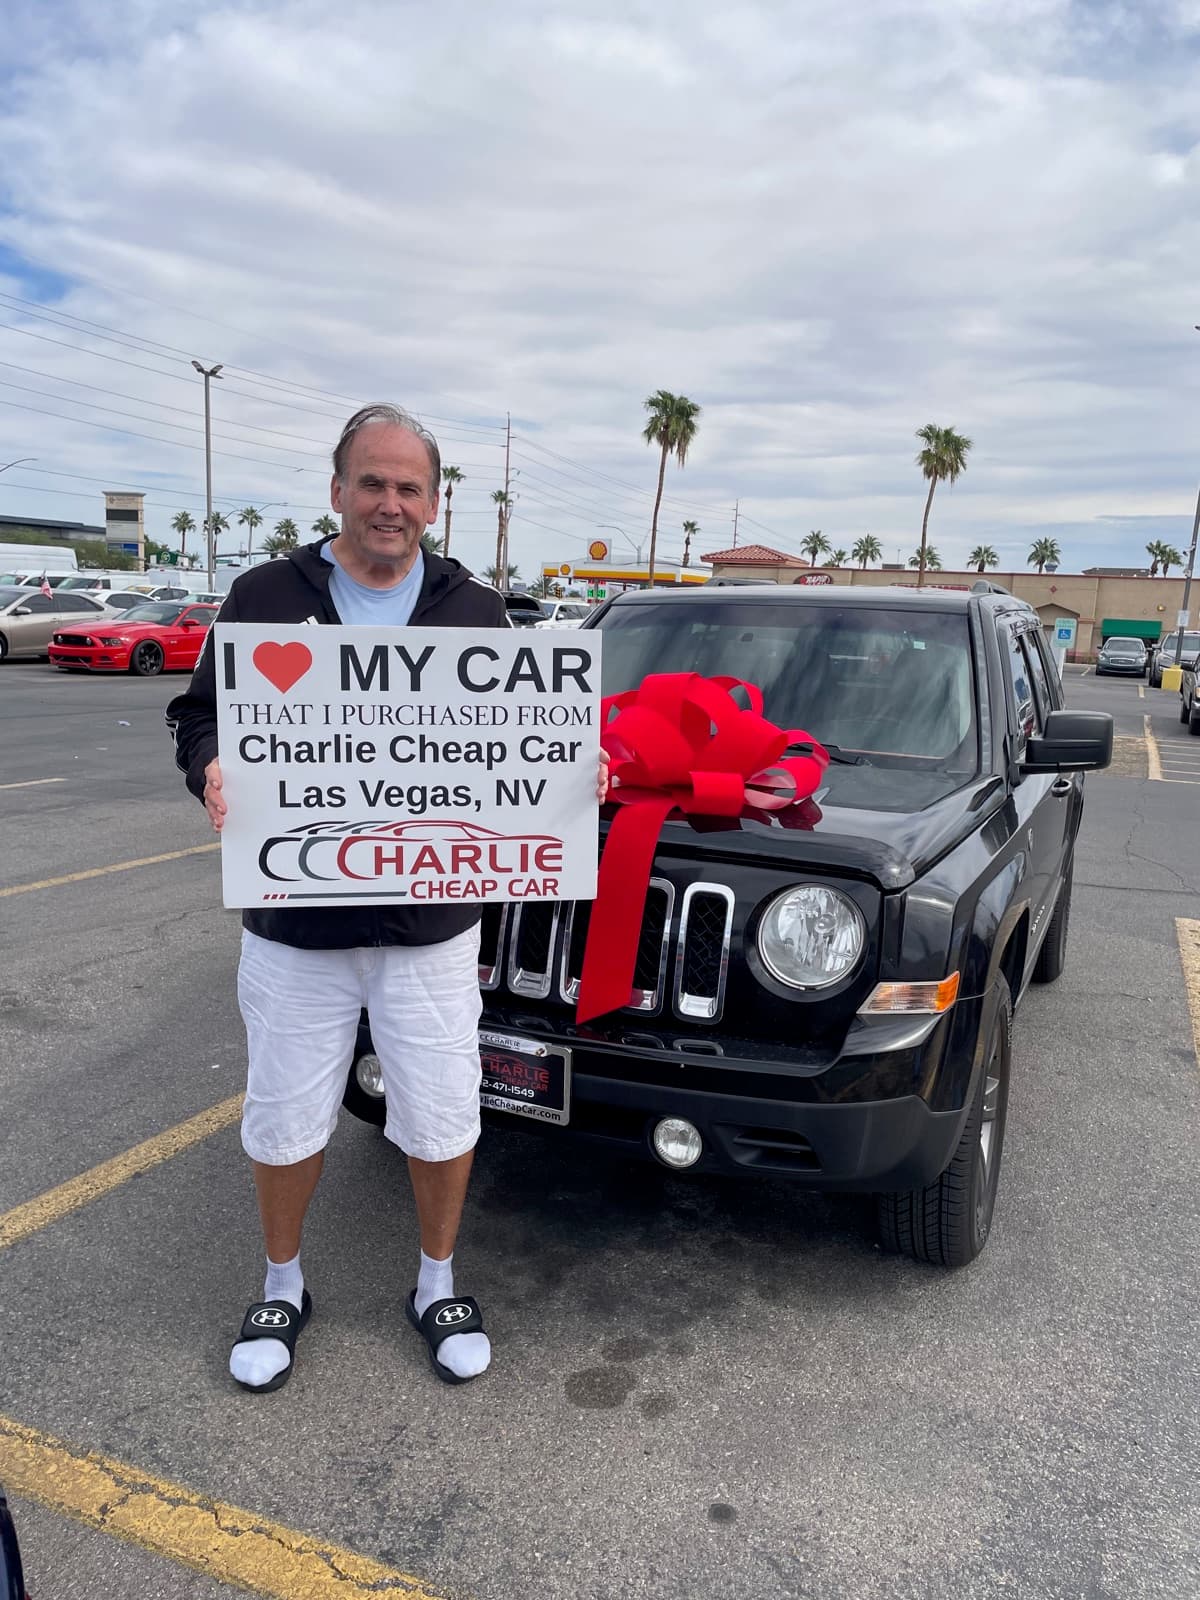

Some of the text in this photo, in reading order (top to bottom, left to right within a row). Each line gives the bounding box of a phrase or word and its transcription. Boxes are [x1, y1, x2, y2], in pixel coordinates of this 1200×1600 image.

[224, 642, 593, 693] I MY CAR
[230, 703, 592, 726] THAT I PURCHASED FROM
[238, 733, 582, 771] Charlie Cheap Car
[279, 778, 547, 814] Las Vegas, NV
[410, 878, 559, 899] CHEAP CAR
[480, 1078, 535, 1098] 2-471-1549
[530, 1081, 548, 1092] CAR
[480, 1094, 561, 1121] rlieCheapCar.com
